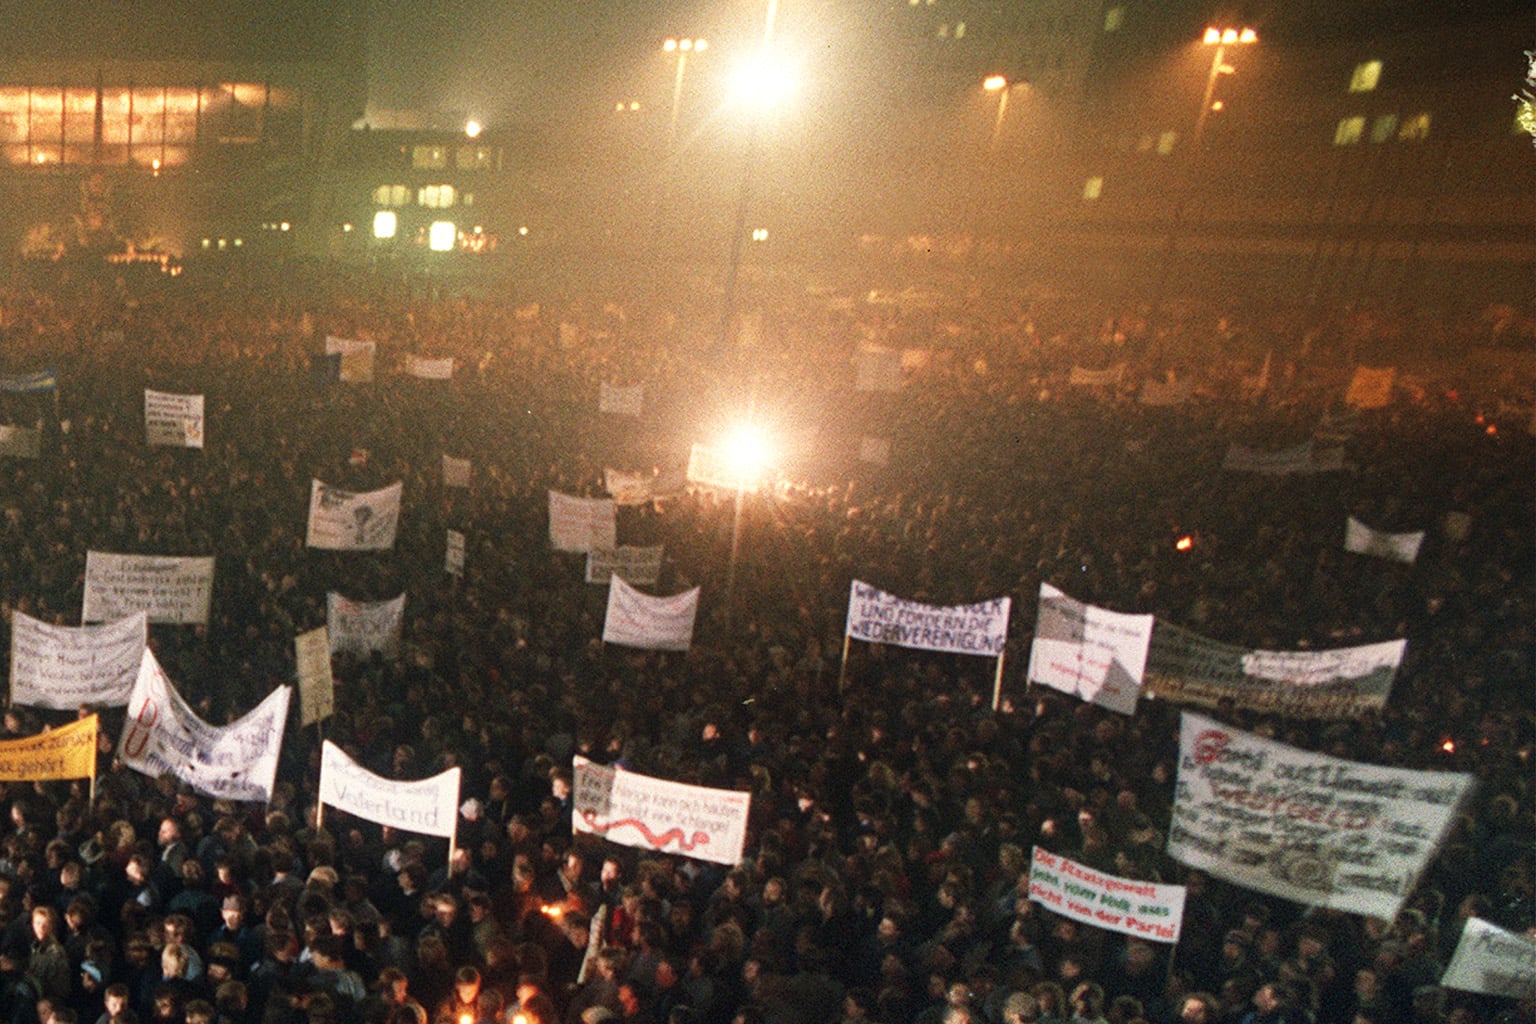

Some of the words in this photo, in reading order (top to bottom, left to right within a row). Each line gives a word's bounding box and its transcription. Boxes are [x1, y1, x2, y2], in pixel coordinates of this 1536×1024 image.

[861, 602, 894, 621] UND
[898, 607, 965, 630] FORDERN
[967, 615, 992, 632] DIE
[332, 778, 441, 829] Vaterland
[1034, 848, 1057, 869] Die
[1064, 881, 1097, 903] vom
[1066, 899, 1093, 918] von
[1094, 909, 1122, 926] der
[1125, 916, 1177, 940] Partei
